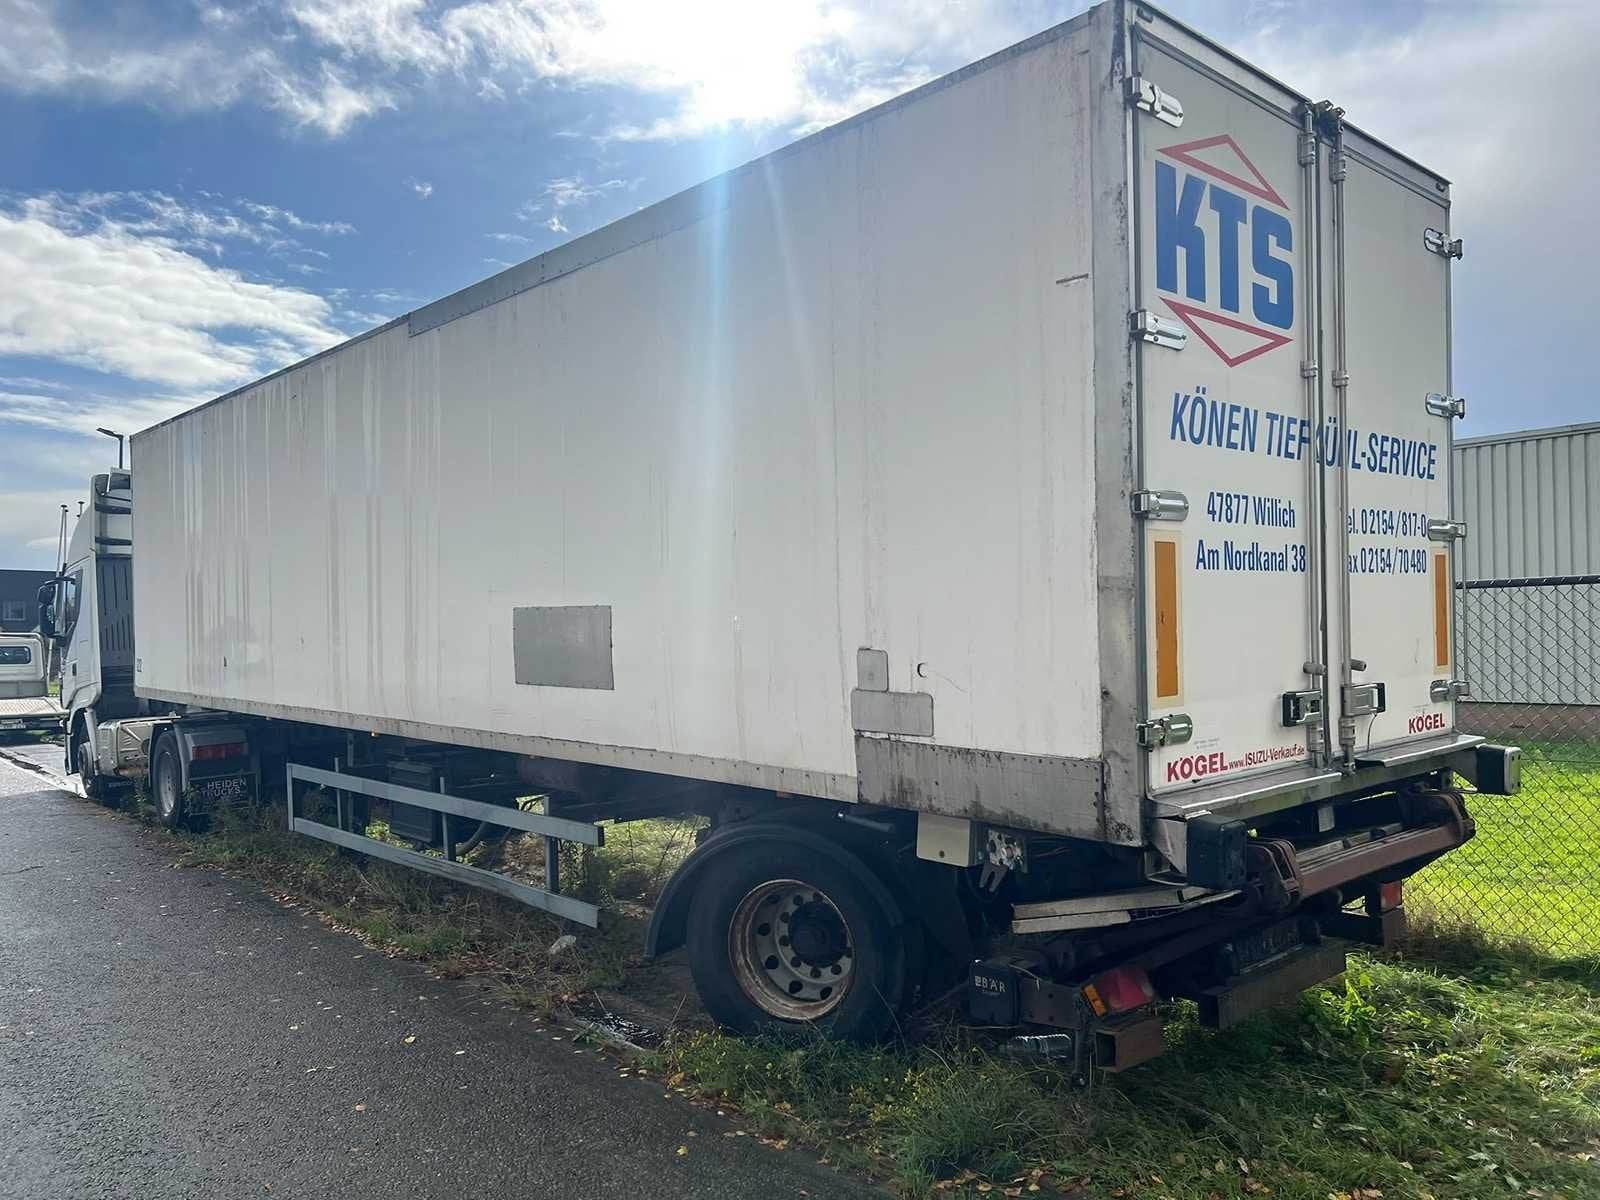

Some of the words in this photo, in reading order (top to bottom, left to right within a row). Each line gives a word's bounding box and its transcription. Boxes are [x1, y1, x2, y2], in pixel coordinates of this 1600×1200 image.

[1154, 159, 1294, 330] KTS
[1170, 385, 1258, 452] KÖNEN
[1207, 491, 1249, 525] 47877
[1253, 495, 1296, 528] Willich
[1196, 539, 1219, 570] Am
[1223, 540, 1288, 572] Nordkanal
[1291, 544, 1306, 573] 38
[1408, 712, 1445, 734] KÖGEL
[1167, 751, 1229, 782] KÖGEL
[1229, 743, 1305, 770] www.ISUZU-Verkauf.de
[207, 778, 247, 790] HEIDEN
[982, 977, 1006, 992] BÄR
